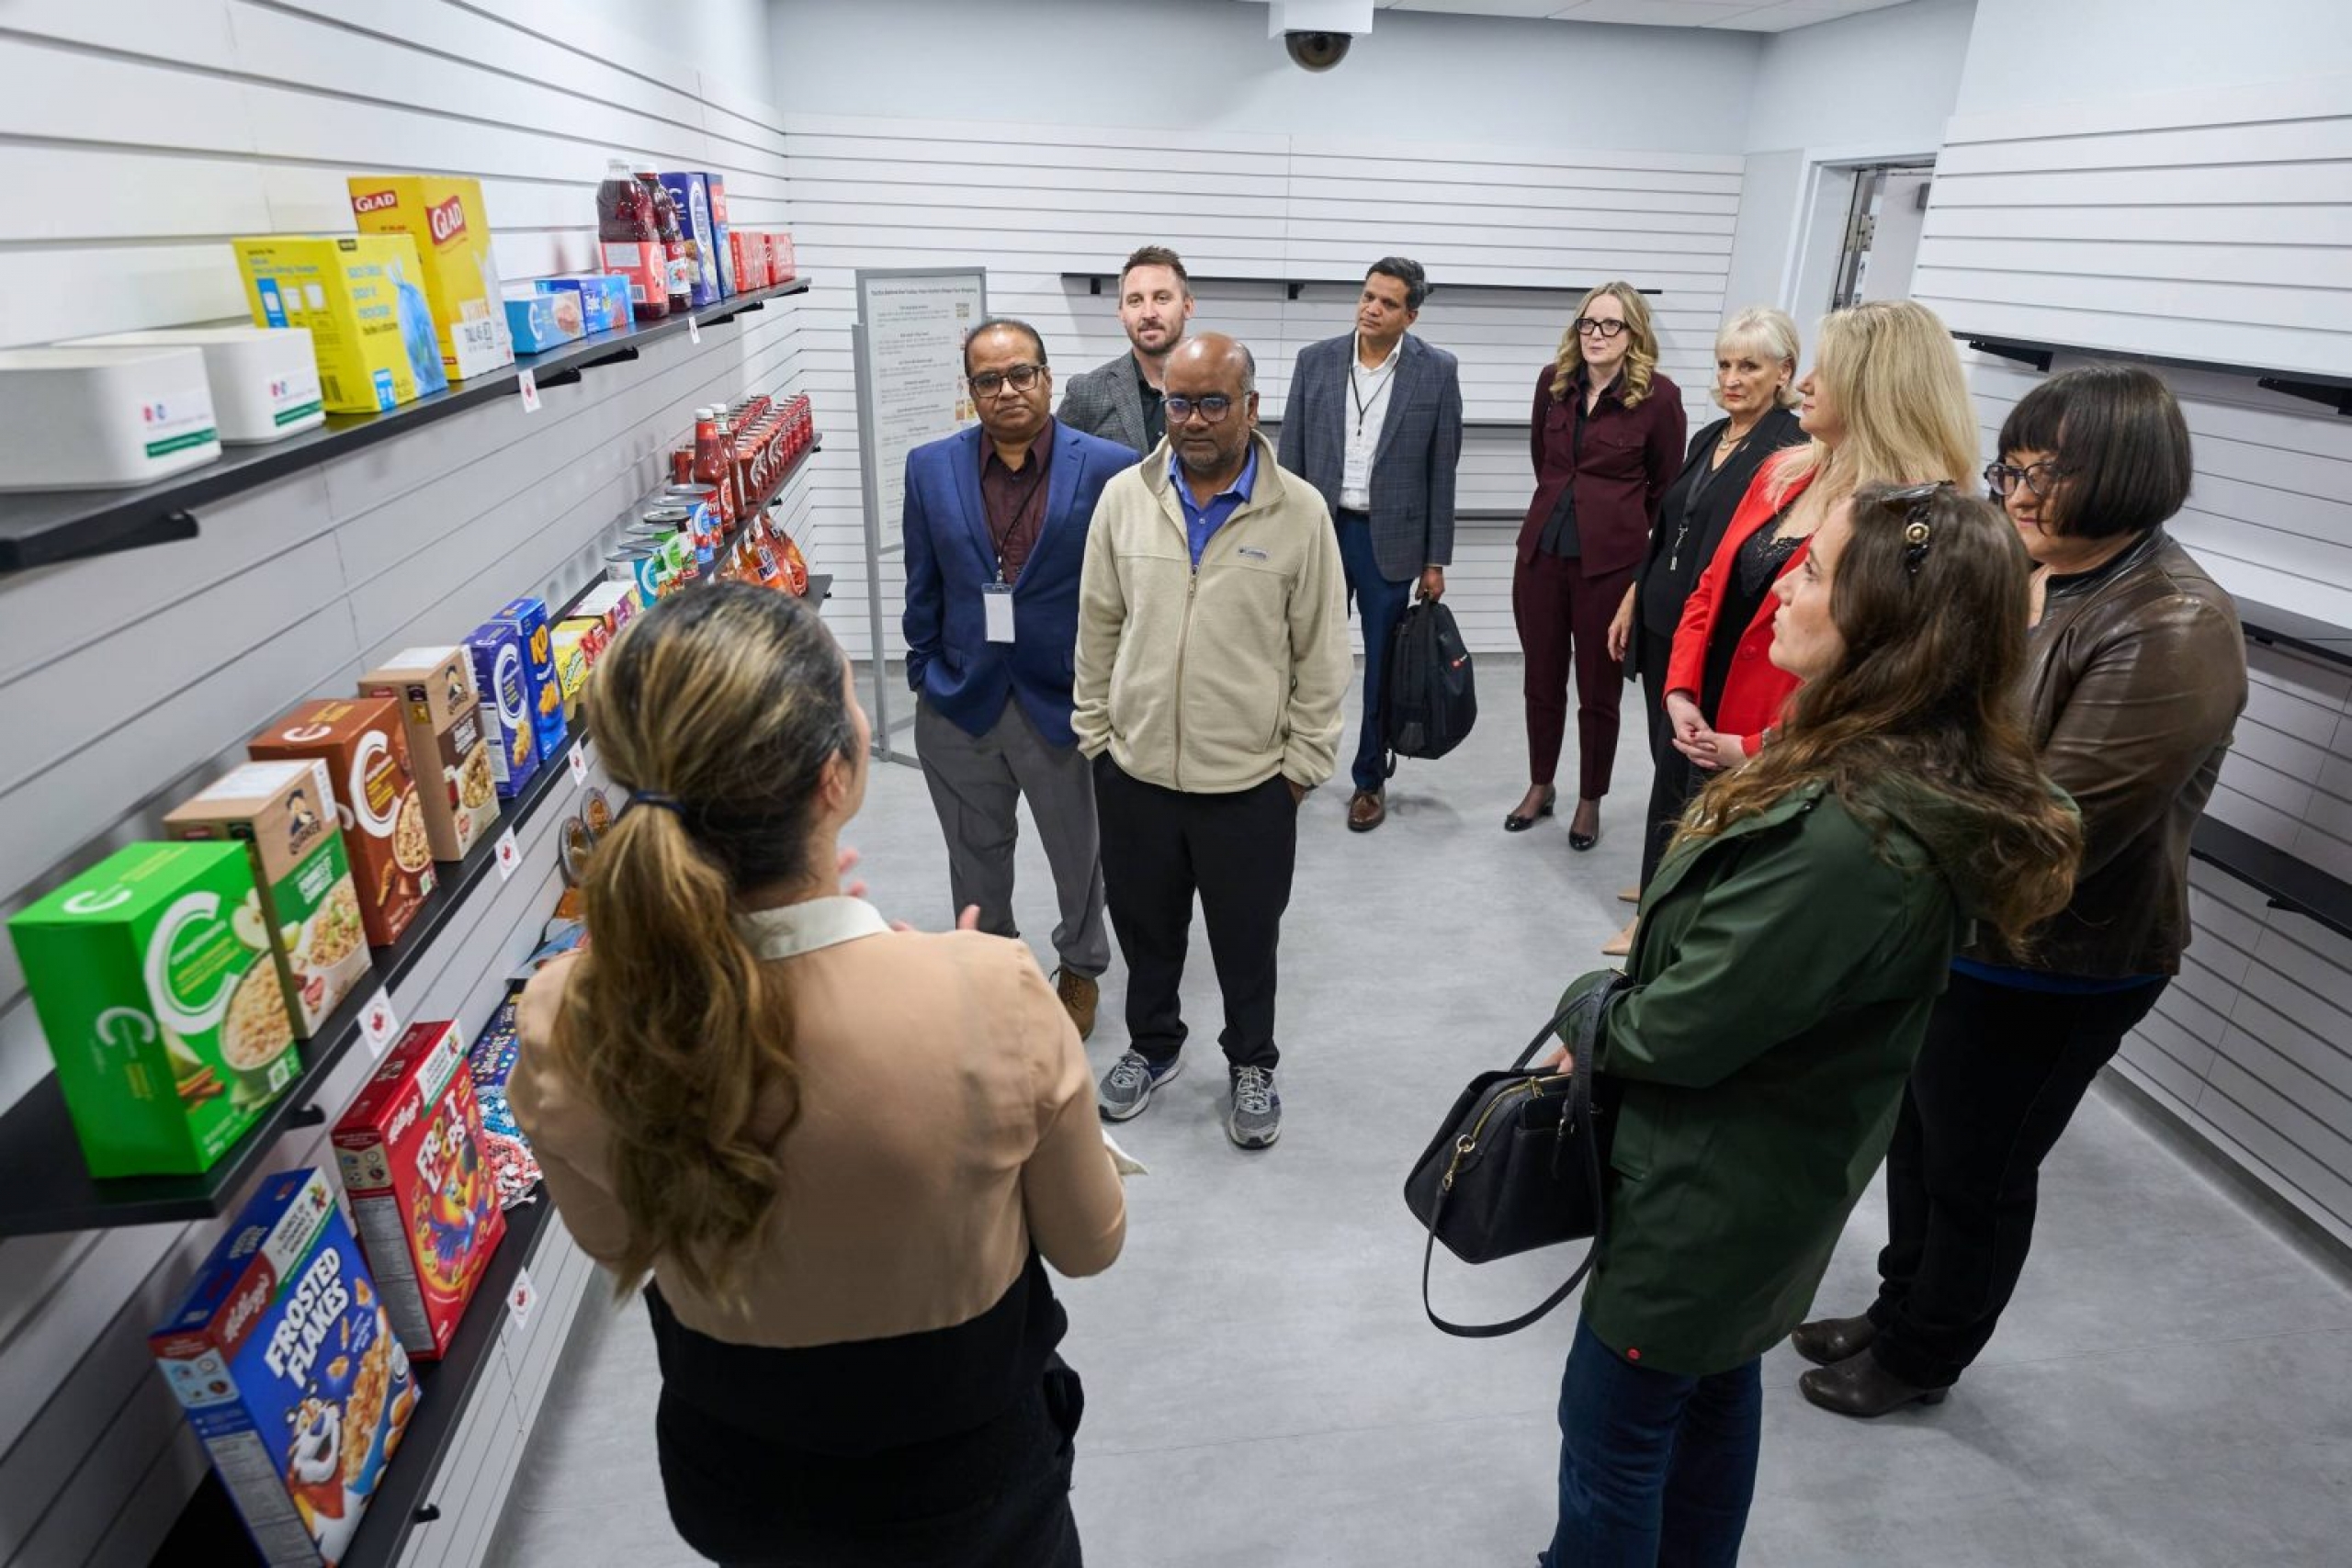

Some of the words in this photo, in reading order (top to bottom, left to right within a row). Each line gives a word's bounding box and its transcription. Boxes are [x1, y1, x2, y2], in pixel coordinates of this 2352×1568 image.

[355, 192, 396, 213] GLAD
[431, 203, 463, 241] GLAD
[265, 1247, 341, 1379] FROSTED
[287, 1273, 349, 1390] FLAKES
